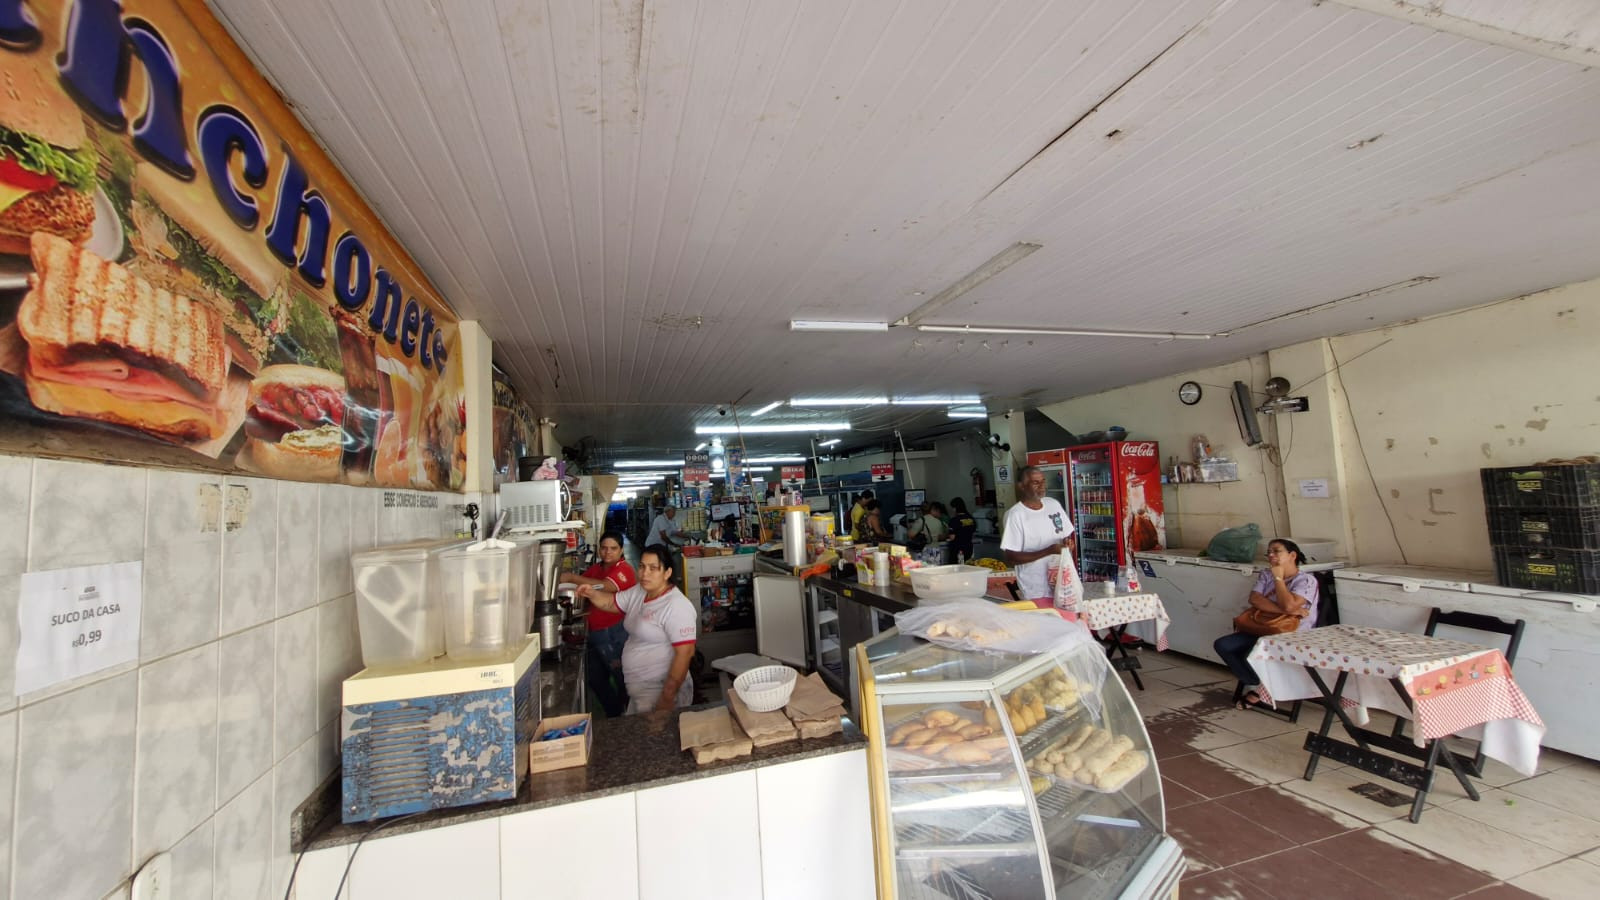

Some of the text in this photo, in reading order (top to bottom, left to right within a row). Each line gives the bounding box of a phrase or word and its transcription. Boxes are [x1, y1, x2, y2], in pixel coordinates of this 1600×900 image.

[0, 0, 448, 376] nchonete
[1121, 442, 1155, 457] Coca-Cola
[1143, 562, 1149, 571] 2
[51, 603, 121, 627] SUCO DA CASA
